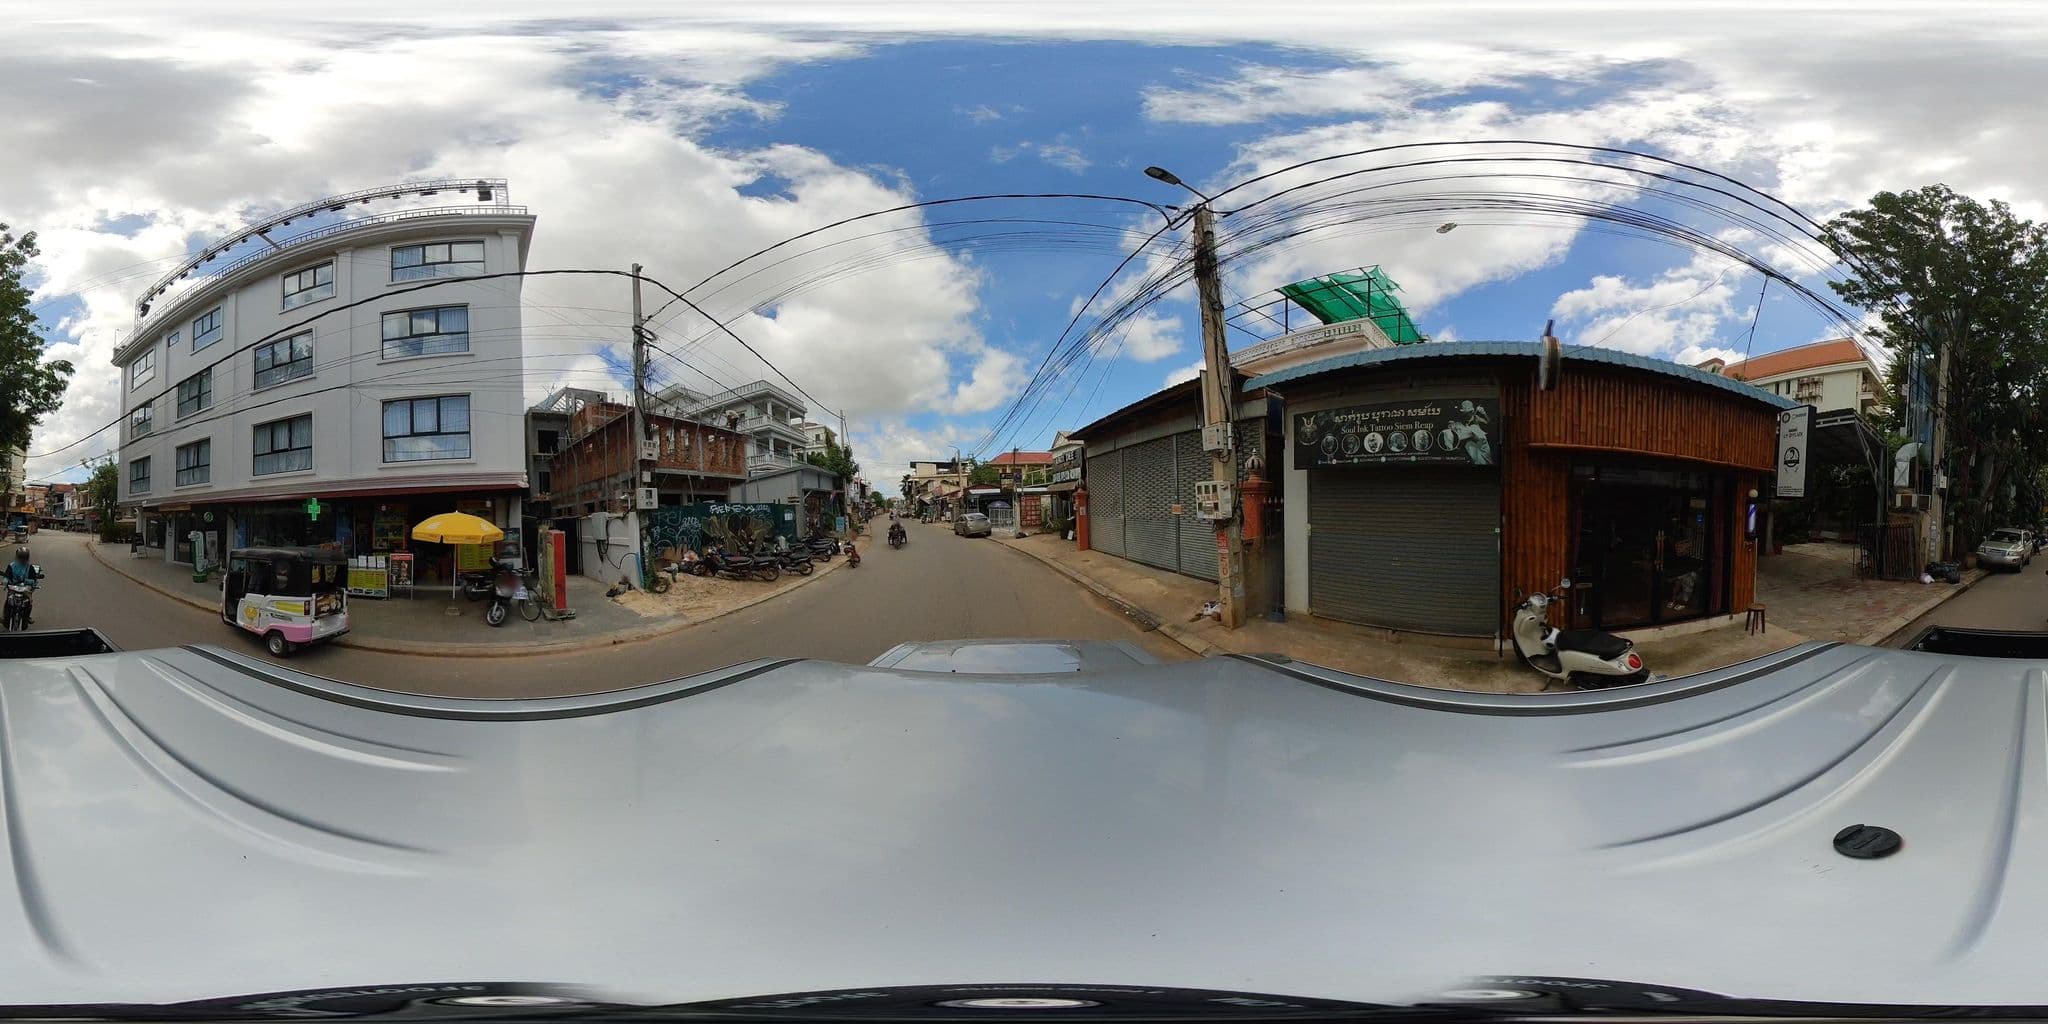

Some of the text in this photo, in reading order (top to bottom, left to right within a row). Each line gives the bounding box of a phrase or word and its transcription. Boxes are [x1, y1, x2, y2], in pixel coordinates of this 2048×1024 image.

[1341, 421, 1433, 434] Soul Ink Tattoo Siem Reap
